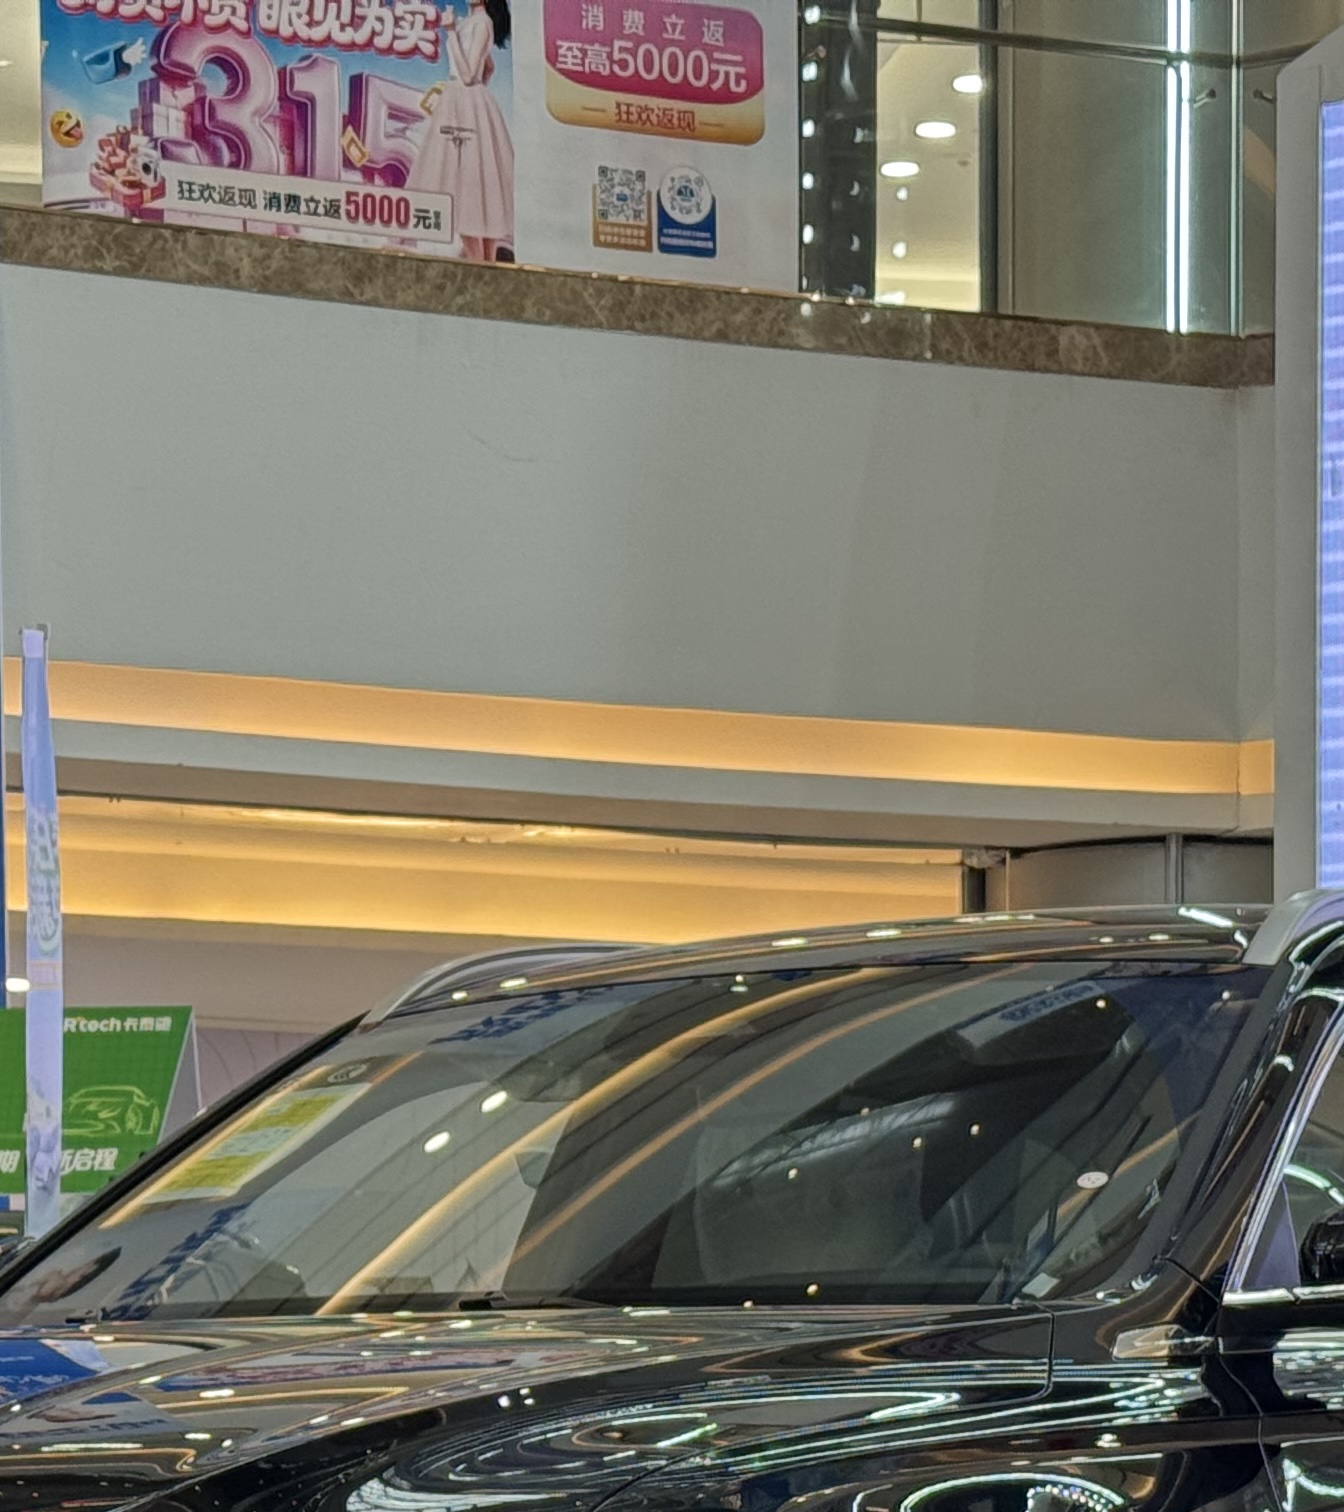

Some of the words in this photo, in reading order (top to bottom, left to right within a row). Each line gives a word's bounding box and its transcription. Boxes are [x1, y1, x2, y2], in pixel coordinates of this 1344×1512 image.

[580, 4, 725, 47] 消费立返
[556, 39, 748, 94] 至高5000元
[614, 101, 697, 132] 狂欢返现
[177, 179, 257, 210] 狂欢返现
